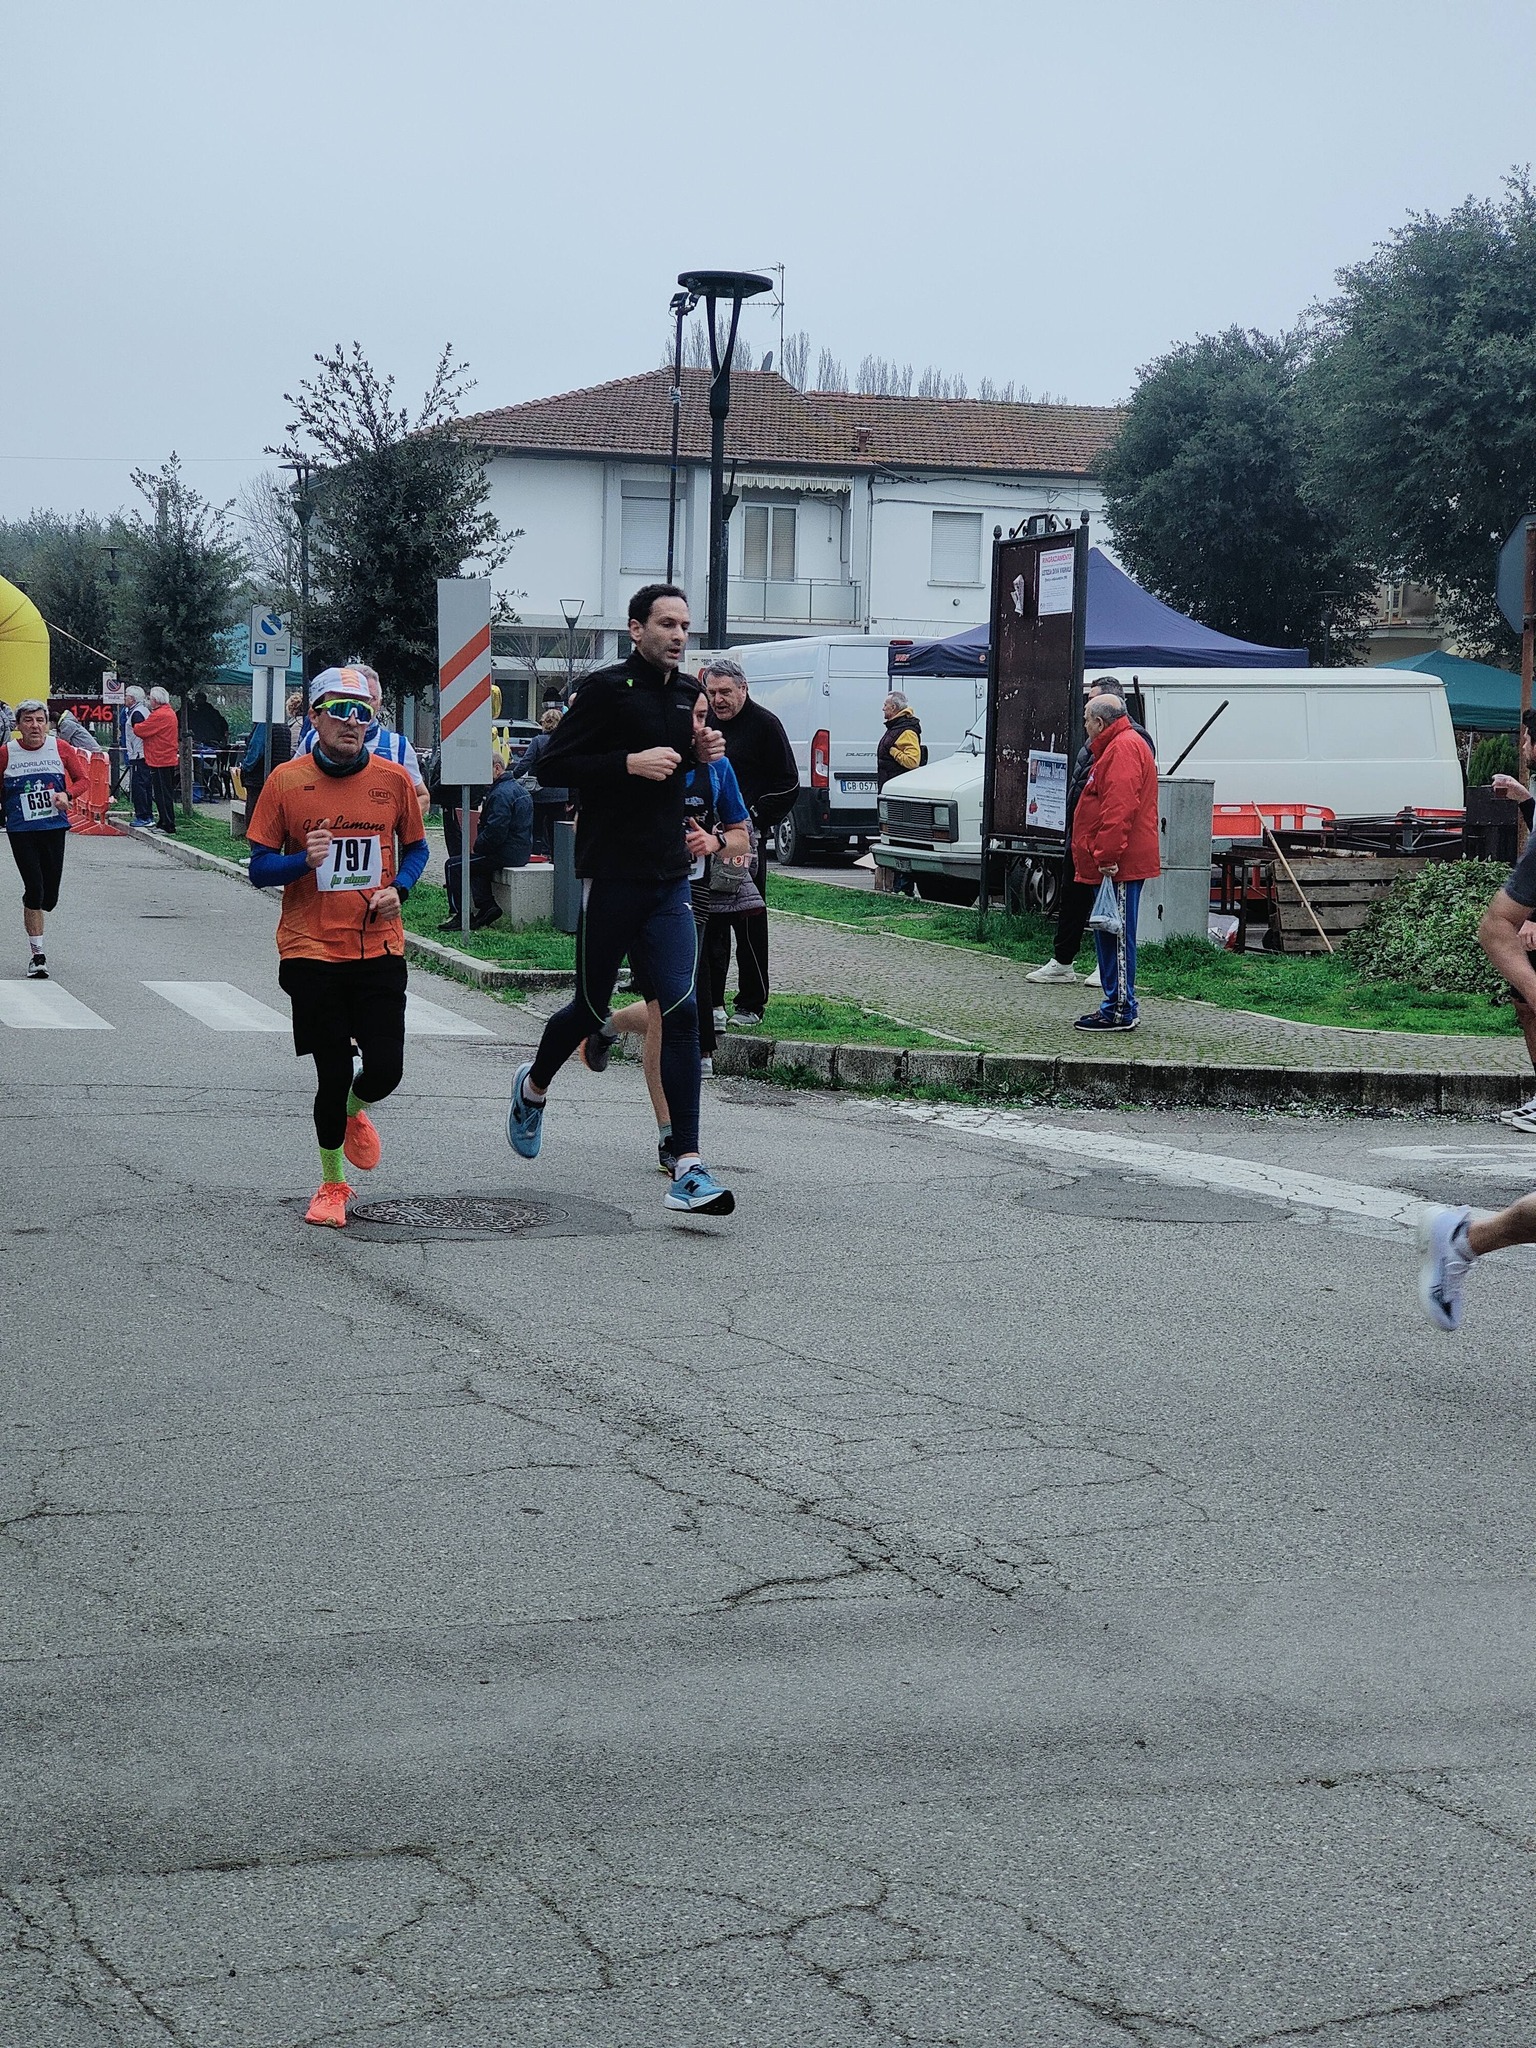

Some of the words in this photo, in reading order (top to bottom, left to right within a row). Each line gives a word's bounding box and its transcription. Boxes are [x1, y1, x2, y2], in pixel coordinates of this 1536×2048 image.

[257, 644, 264, 653] P
[70, 705, 113, 721] 17:46
[11, 760, 61, 770] QUADRILATERO
[859, 782, 876, 790] 057T
[27, 791, 52, 810] 639
[330, 815, 384, 831] Lamone
[332, 839, 371, 872] 797
[684, 1179, 700, 1193] N
